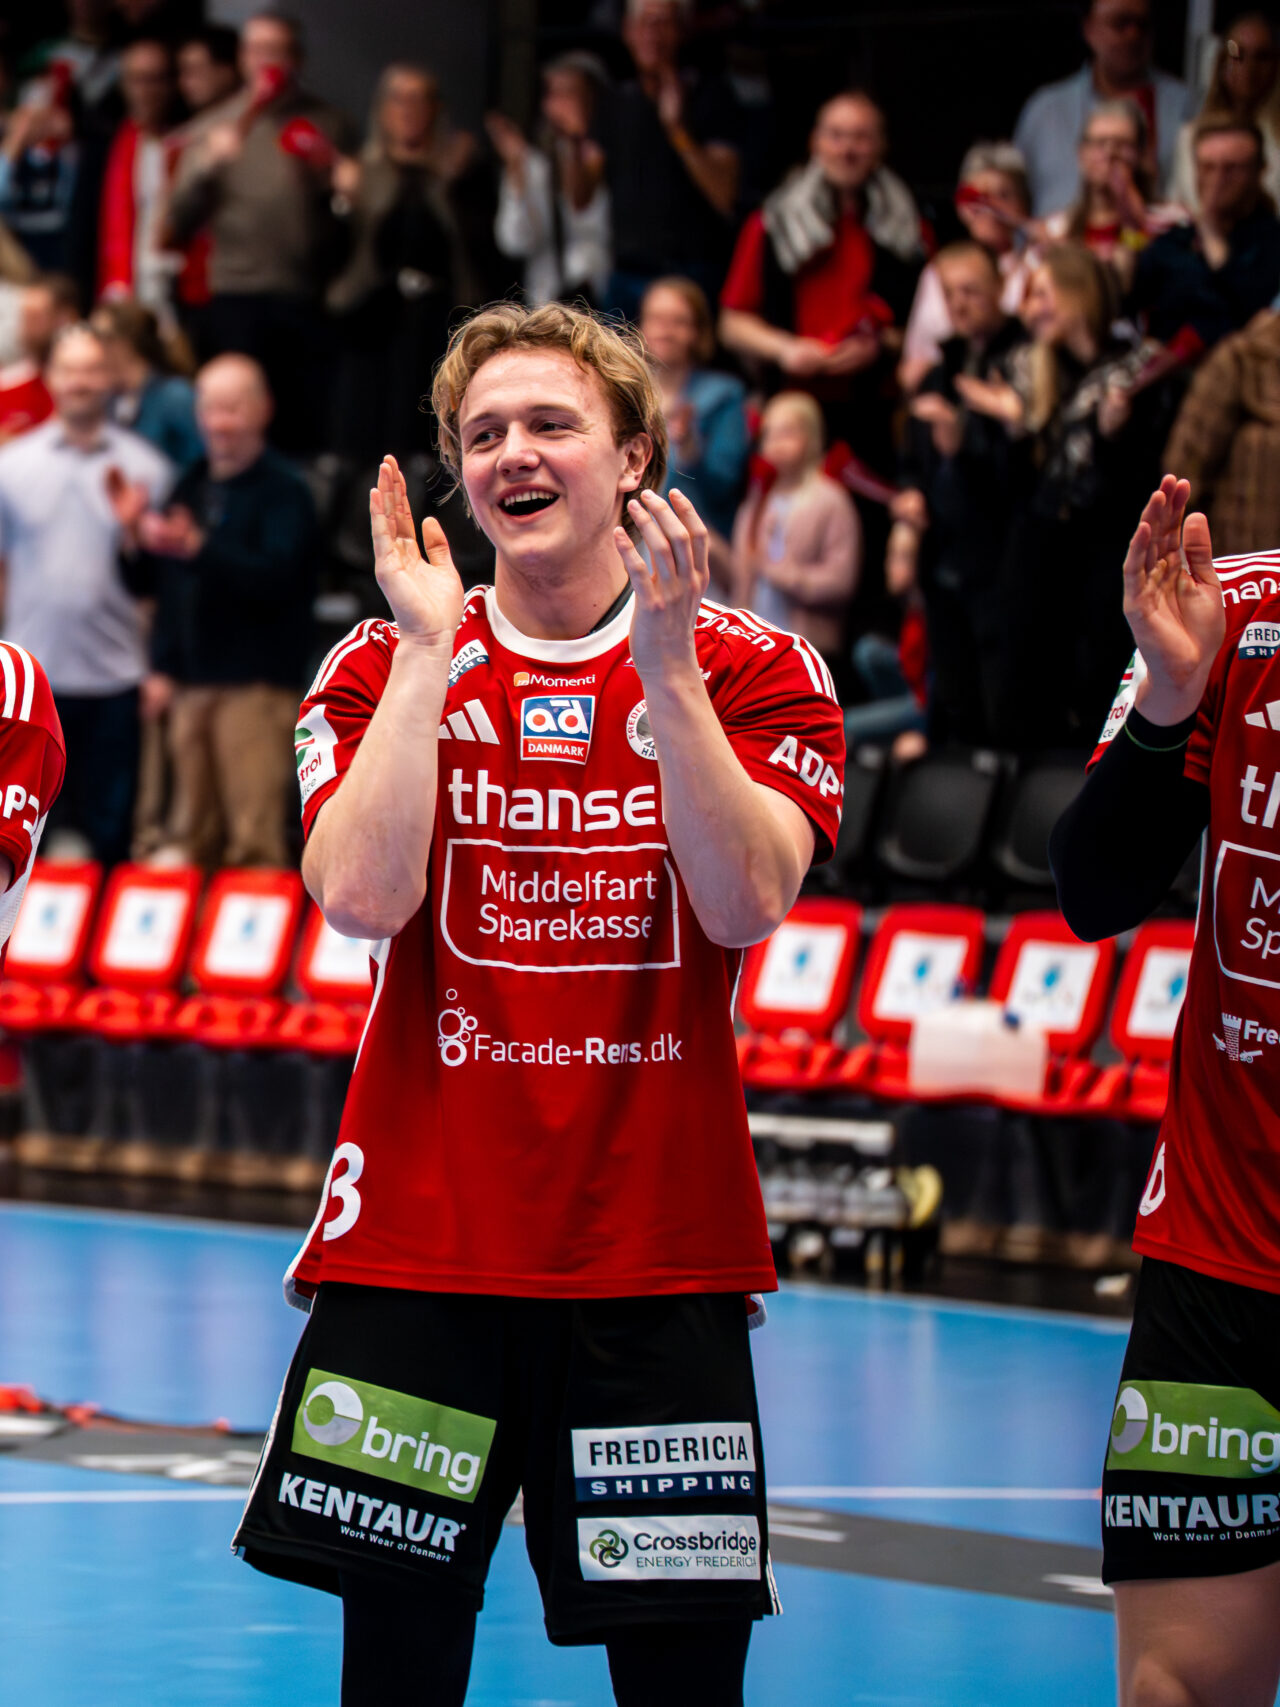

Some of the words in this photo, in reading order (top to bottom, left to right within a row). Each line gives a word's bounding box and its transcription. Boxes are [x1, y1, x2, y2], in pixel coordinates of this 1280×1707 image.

[530, 673, 596, 687] Momenti
[528, 743, 585, 757] DANMARK
[448, 768, 660, 832] thanse
[481, 864, 657, 903] Middelfart
[478, 903, 652, 943] Sparekasse
[322, 1141, 365, 1242] 3
[361, 1416, 481, 1495] bring
[589, 1436, 748, 1466] FREDERICIA
[1151, 1413, 1280, 1473] bring
[591, 1476, 751, 1495] SHIPPING
[340, 1525, 366, 1540] Work
[369, 1533, 394, 1548] Wear
[397, 1542, 408, 1551] of
[410, 1545, 451, 1562] Denmark
[633, 1531, 757, 1556] Crossbridge
[1153, 1532, 1180, 1541] Work
[1185, 1532, 1214, 1541] Wear
[1220, 1532, 1230, 1540] of
[636, 1556, 692, 1568] ENERGY
[696, 1556, 756, 1568] FREDERICIA
